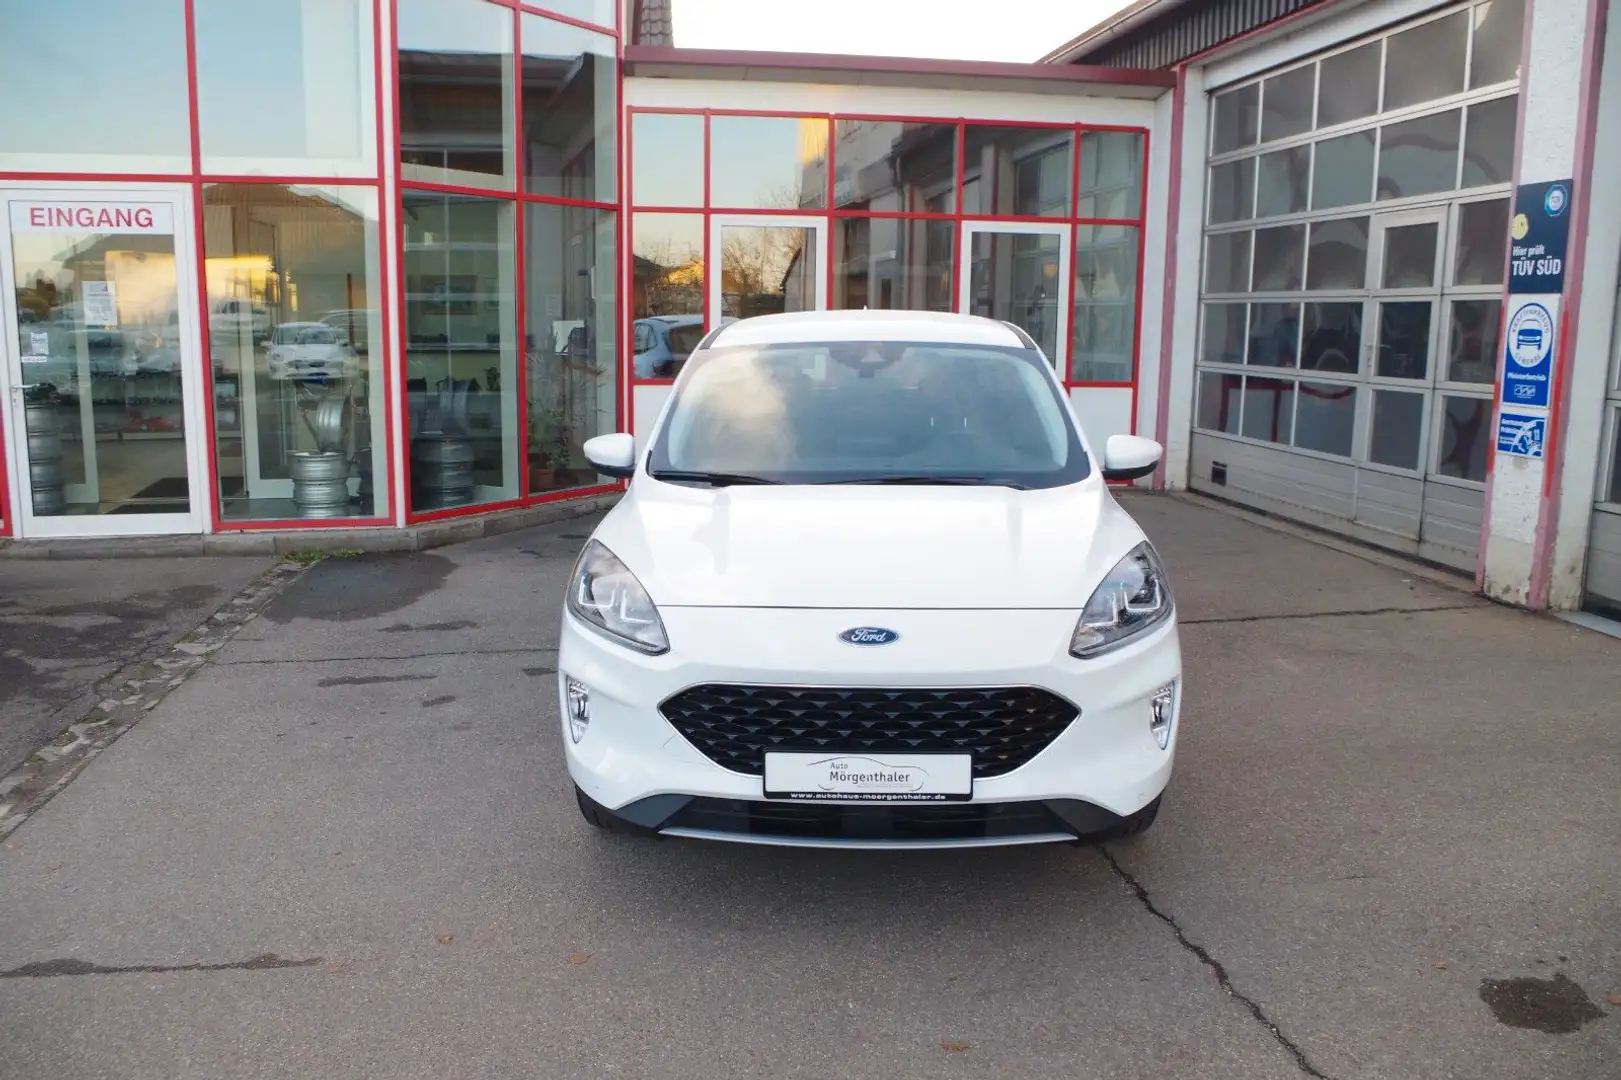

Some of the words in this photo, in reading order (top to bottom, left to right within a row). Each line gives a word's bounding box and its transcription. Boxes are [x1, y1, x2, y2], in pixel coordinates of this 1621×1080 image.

[30, 207, 154, 228] EINGANG
[1512, 246, 1527, 257] Hier
[1528, 244, 1545, 258] prüft
[1512, 256, 1535, 276] TÜV
[1536, 255, 1562, 276] SÜD
[851, 629, 887, 642] Ford
[830, 762, 849, 770] Auto
[829, 771, 911, 785] Mörgenthaler
